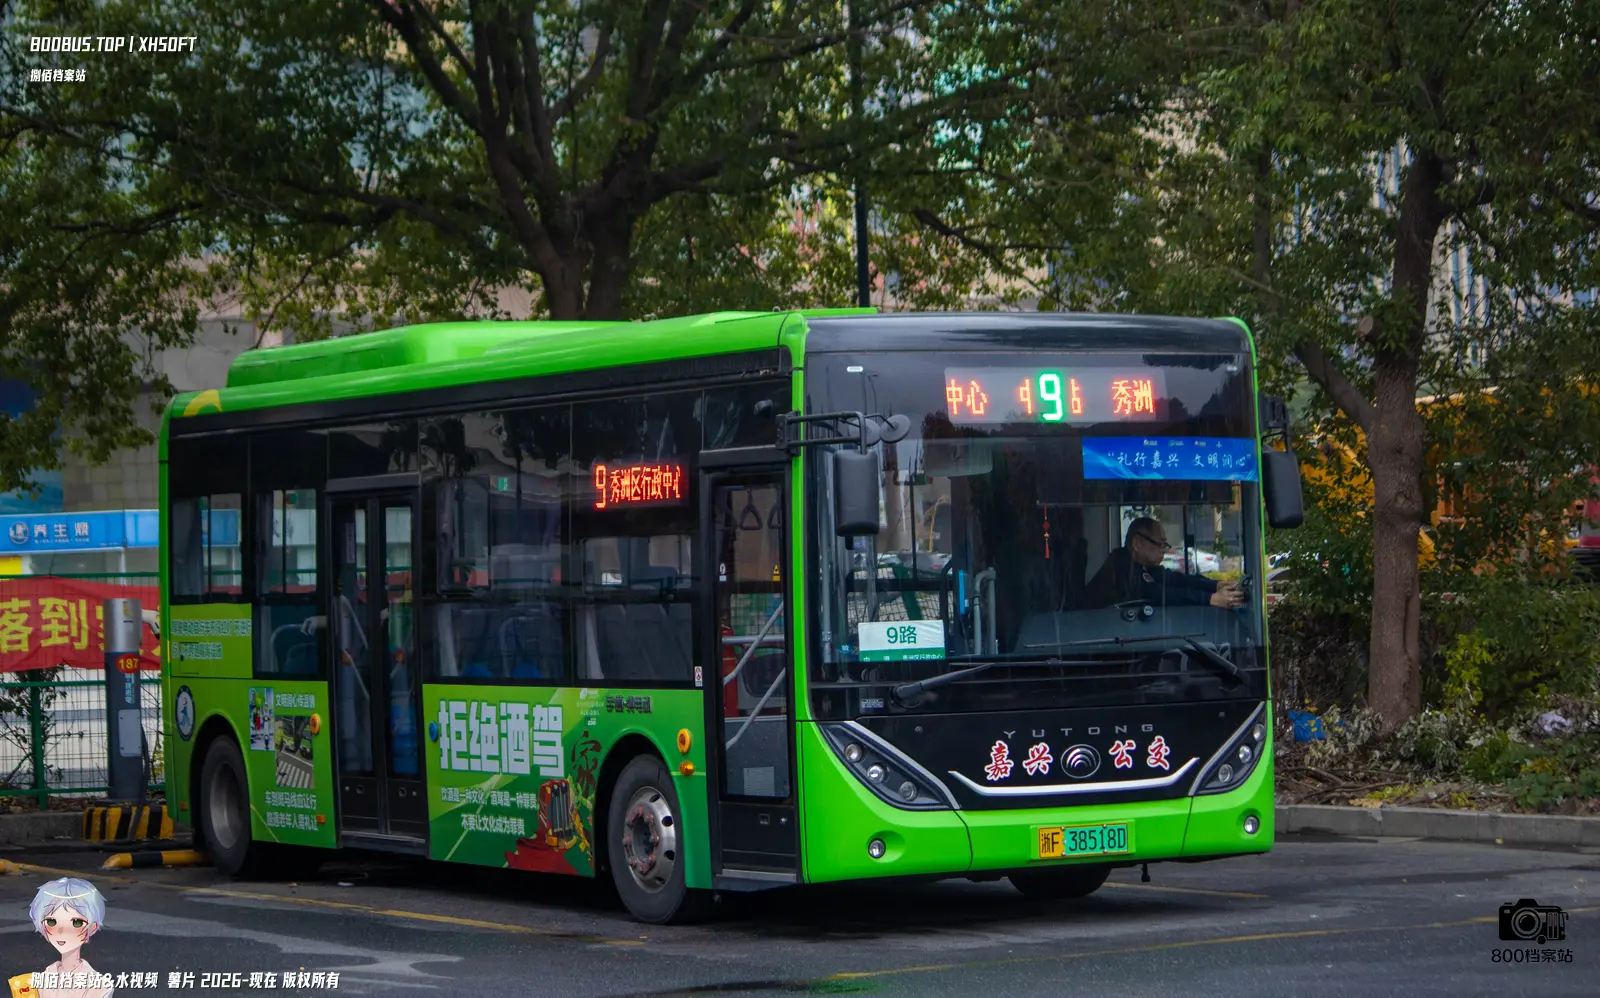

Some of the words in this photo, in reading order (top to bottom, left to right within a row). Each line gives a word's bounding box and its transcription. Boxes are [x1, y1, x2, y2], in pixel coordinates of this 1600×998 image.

[945, 378, 988, 415] 中心
[1039, 373, 1063, 421] 9
[1112, 378, 1154, 414] 秀洲
[595, 465, 606, 508] 9
[0, 597, 105, 654] 落到
[886, 625, 917, 644] 9路
[119, 658, 138, 670] 187
[438, 700, 564, 777] 拒绝酒驾
[1003, 724, 1153, 739] YUTONG
[984, 740, 1053, 782] 嘉兴
[1108, 735, 1170, 770] 公交
